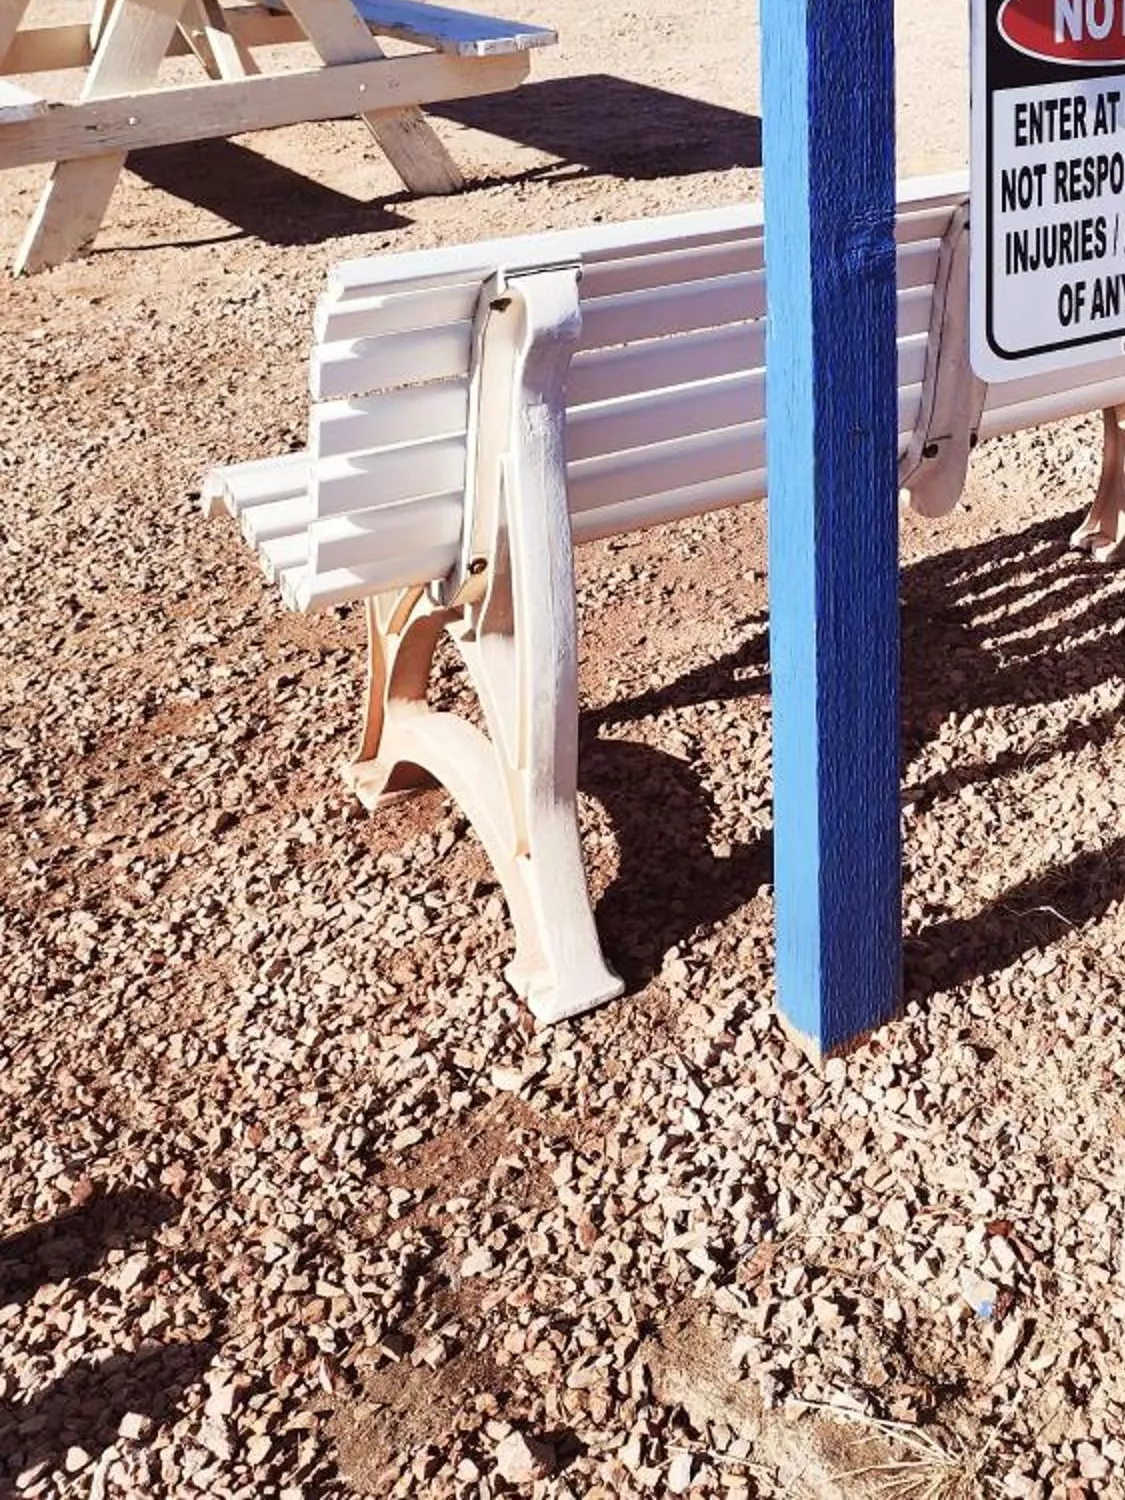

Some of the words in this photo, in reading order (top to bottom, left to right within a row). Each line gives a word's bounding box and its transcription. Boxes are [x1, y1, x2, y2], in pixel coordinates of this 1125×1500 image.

[1015, 96, 1087, 146] ENTER
[1094, 91, 1120, 136] AT
[1002, 164, 1046, 212] NOT
[1006, 216, 1106, 275] INJURIES
[1113, 212, 1118, 256] /
[1058, 282, 1085, 326] OF
